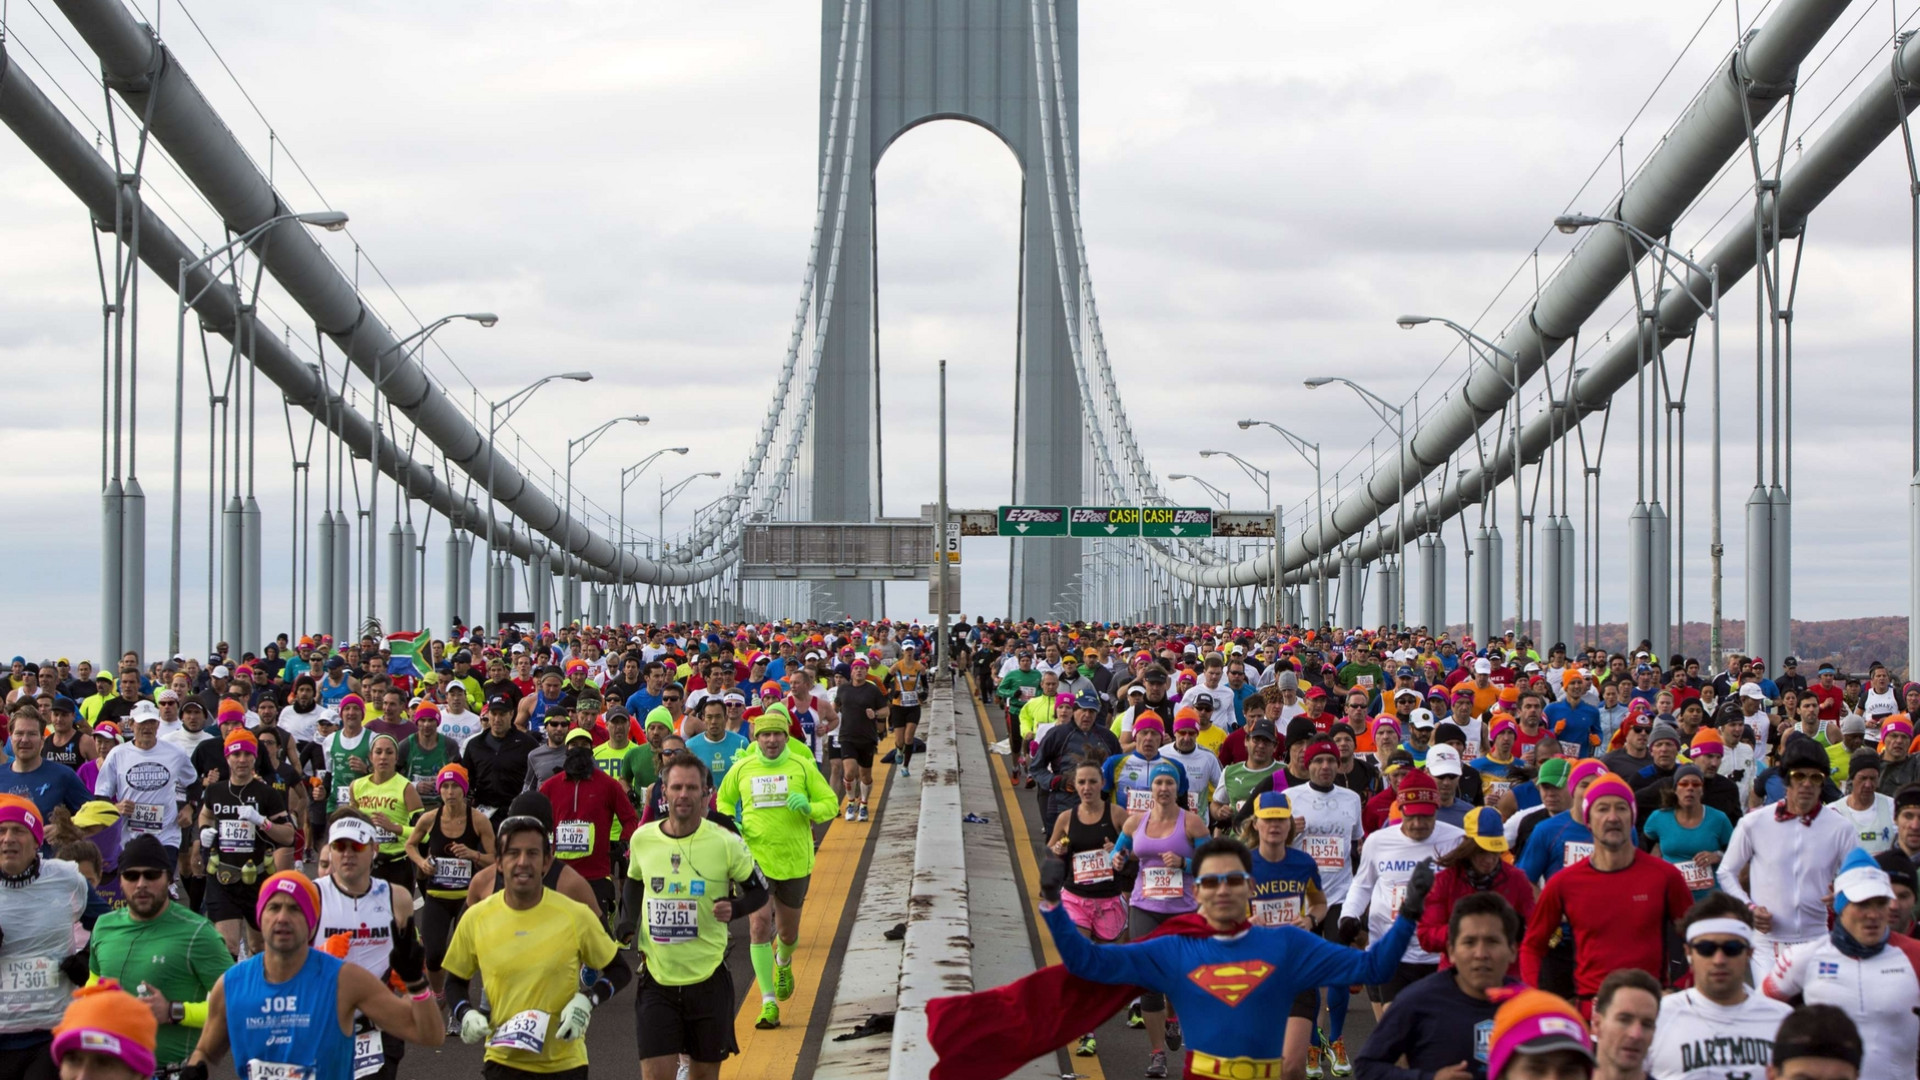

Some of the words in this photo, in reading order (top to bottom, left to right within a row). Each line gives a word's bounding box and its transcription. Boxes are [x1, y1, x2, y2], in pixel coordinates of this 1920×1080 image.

[1110, 510, 1139, 523] CASH
[1144, 510, 1173, 523] CASH
[128, 772, 169, 781] TRIATHLON
[762, 783, 776, 793] 739
[213, 803, 259, 815] Danl
[1133, 799, 1155, 809] 14-50
[136, 811, 157, 821] 8-621
[225, 828, 248, 839] 4-672
[562, 834, 583, 843] 4-072
[1079, 852, 1095, 860] ING
[1311, 845, 1339, 857] 13-574
[1081, 858, 1105, 870] 2-614
[440, 866, 466, 876] 10-677
[1155, 876, 1171, 887] 239
[1253, 881, 1305, 897] SWEDEN
[656, 902, 675, 910] ING
[1263, 902, 1282, 910] ING
[655, 911, 689, 925] 37-151
[1264, 909, 1294, 923] 11-721
[8, 961, 33, 972] ING
[11, 971, 48, 989] 7-301
[261, 996, 297, 1013] JOE
[356, 1040, 371, 1055] 37
[258, 1066, 285, 1077] ING
